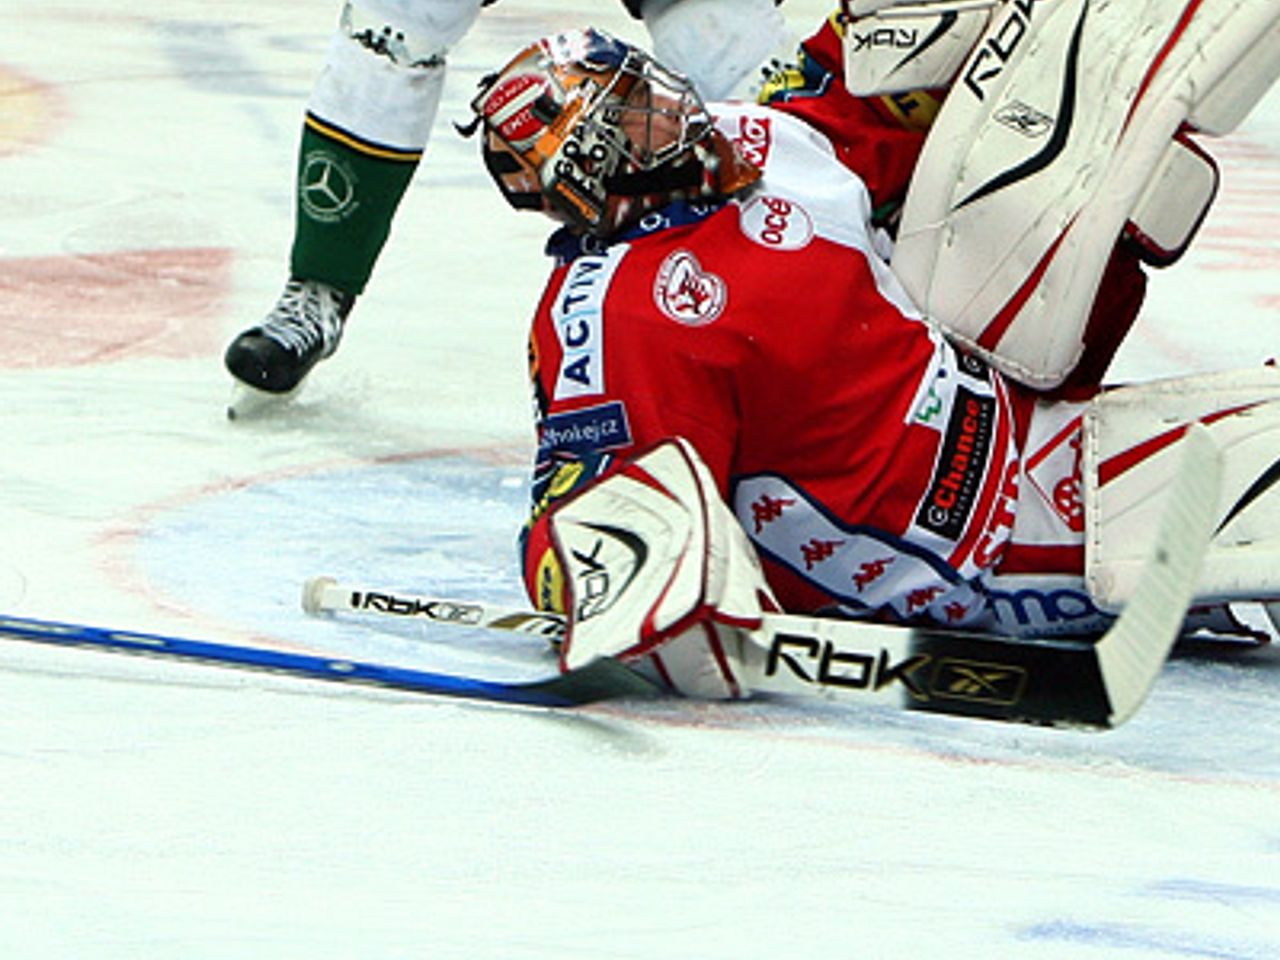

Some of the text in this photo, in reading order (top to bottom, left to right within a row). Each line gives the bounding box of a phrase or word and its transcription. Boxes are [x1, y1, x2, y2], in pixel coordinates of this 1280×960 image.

[759, 195, 793, 246] océ
[933, 399, 982, 510] Chance
[766, 632, 931, 702] Rbk
